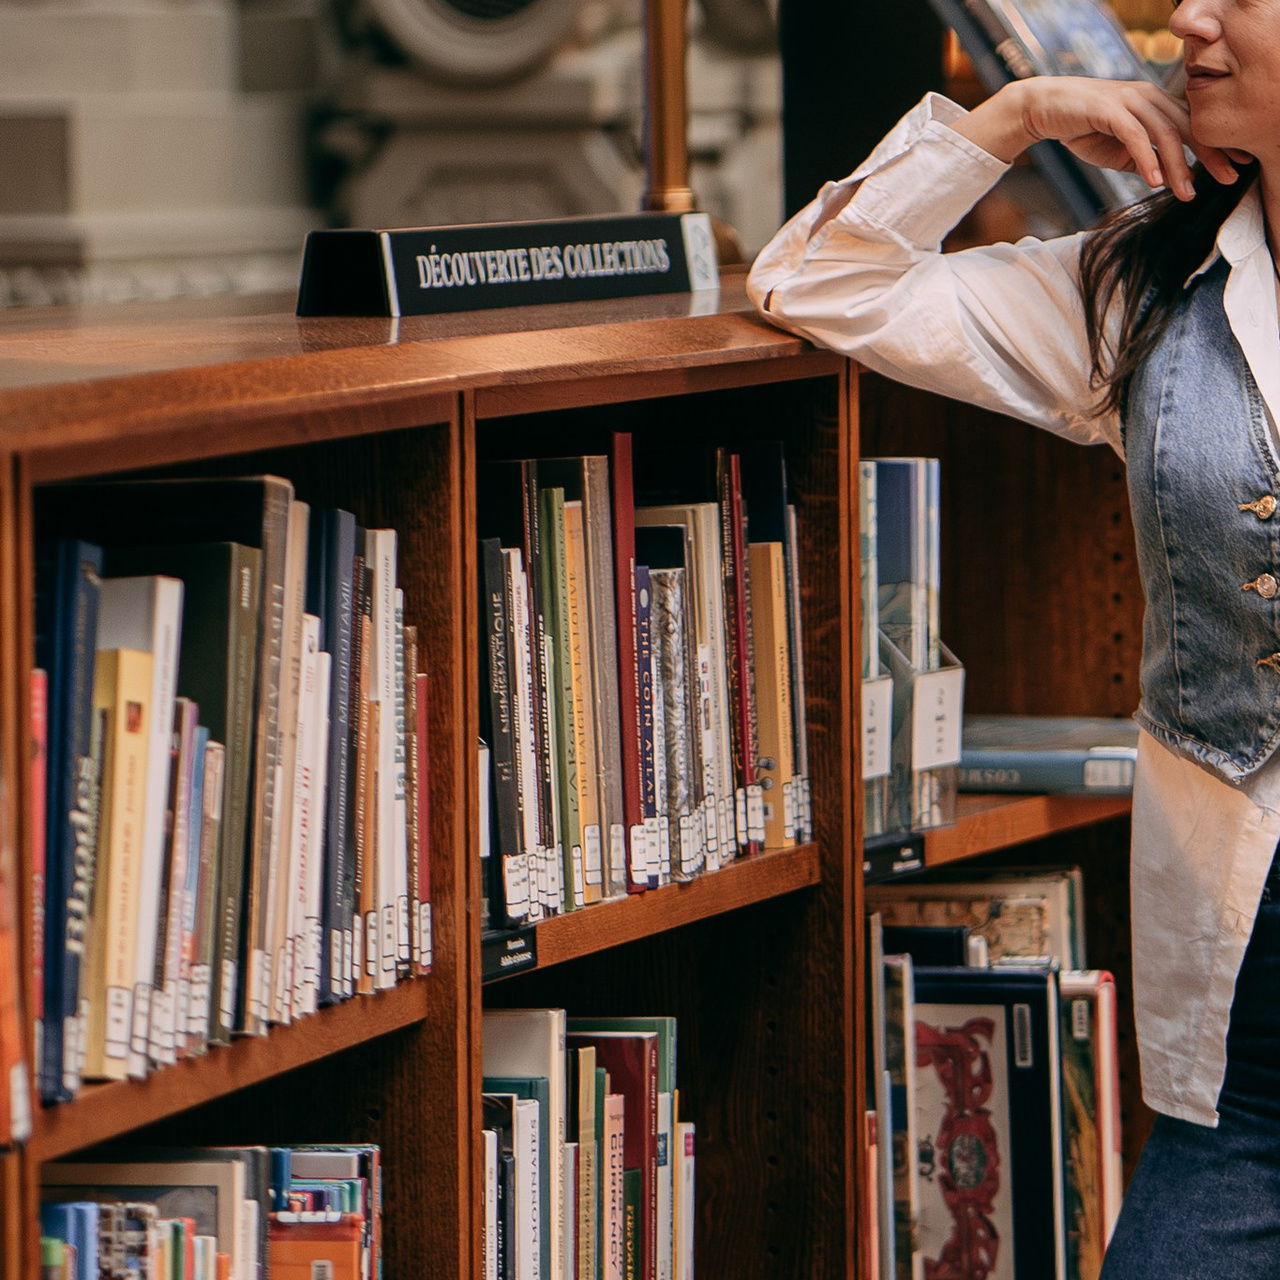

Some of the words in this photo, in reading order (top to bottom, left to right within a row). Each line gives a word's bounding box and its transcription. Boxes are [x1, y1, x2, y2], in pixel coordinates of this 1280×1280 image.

[416, 244, 530, 289] DÉCOUVERTE
[530, 246, 564, 280] DES
[563, 238, 670, 278] COLLECTIONS
[640, 617, 650, 660] THE
[642, 670, 653, 727] COIN
[645, 738, 654, 804] ATLAS
[530, 1119, 538, 1244] MONNAIES
